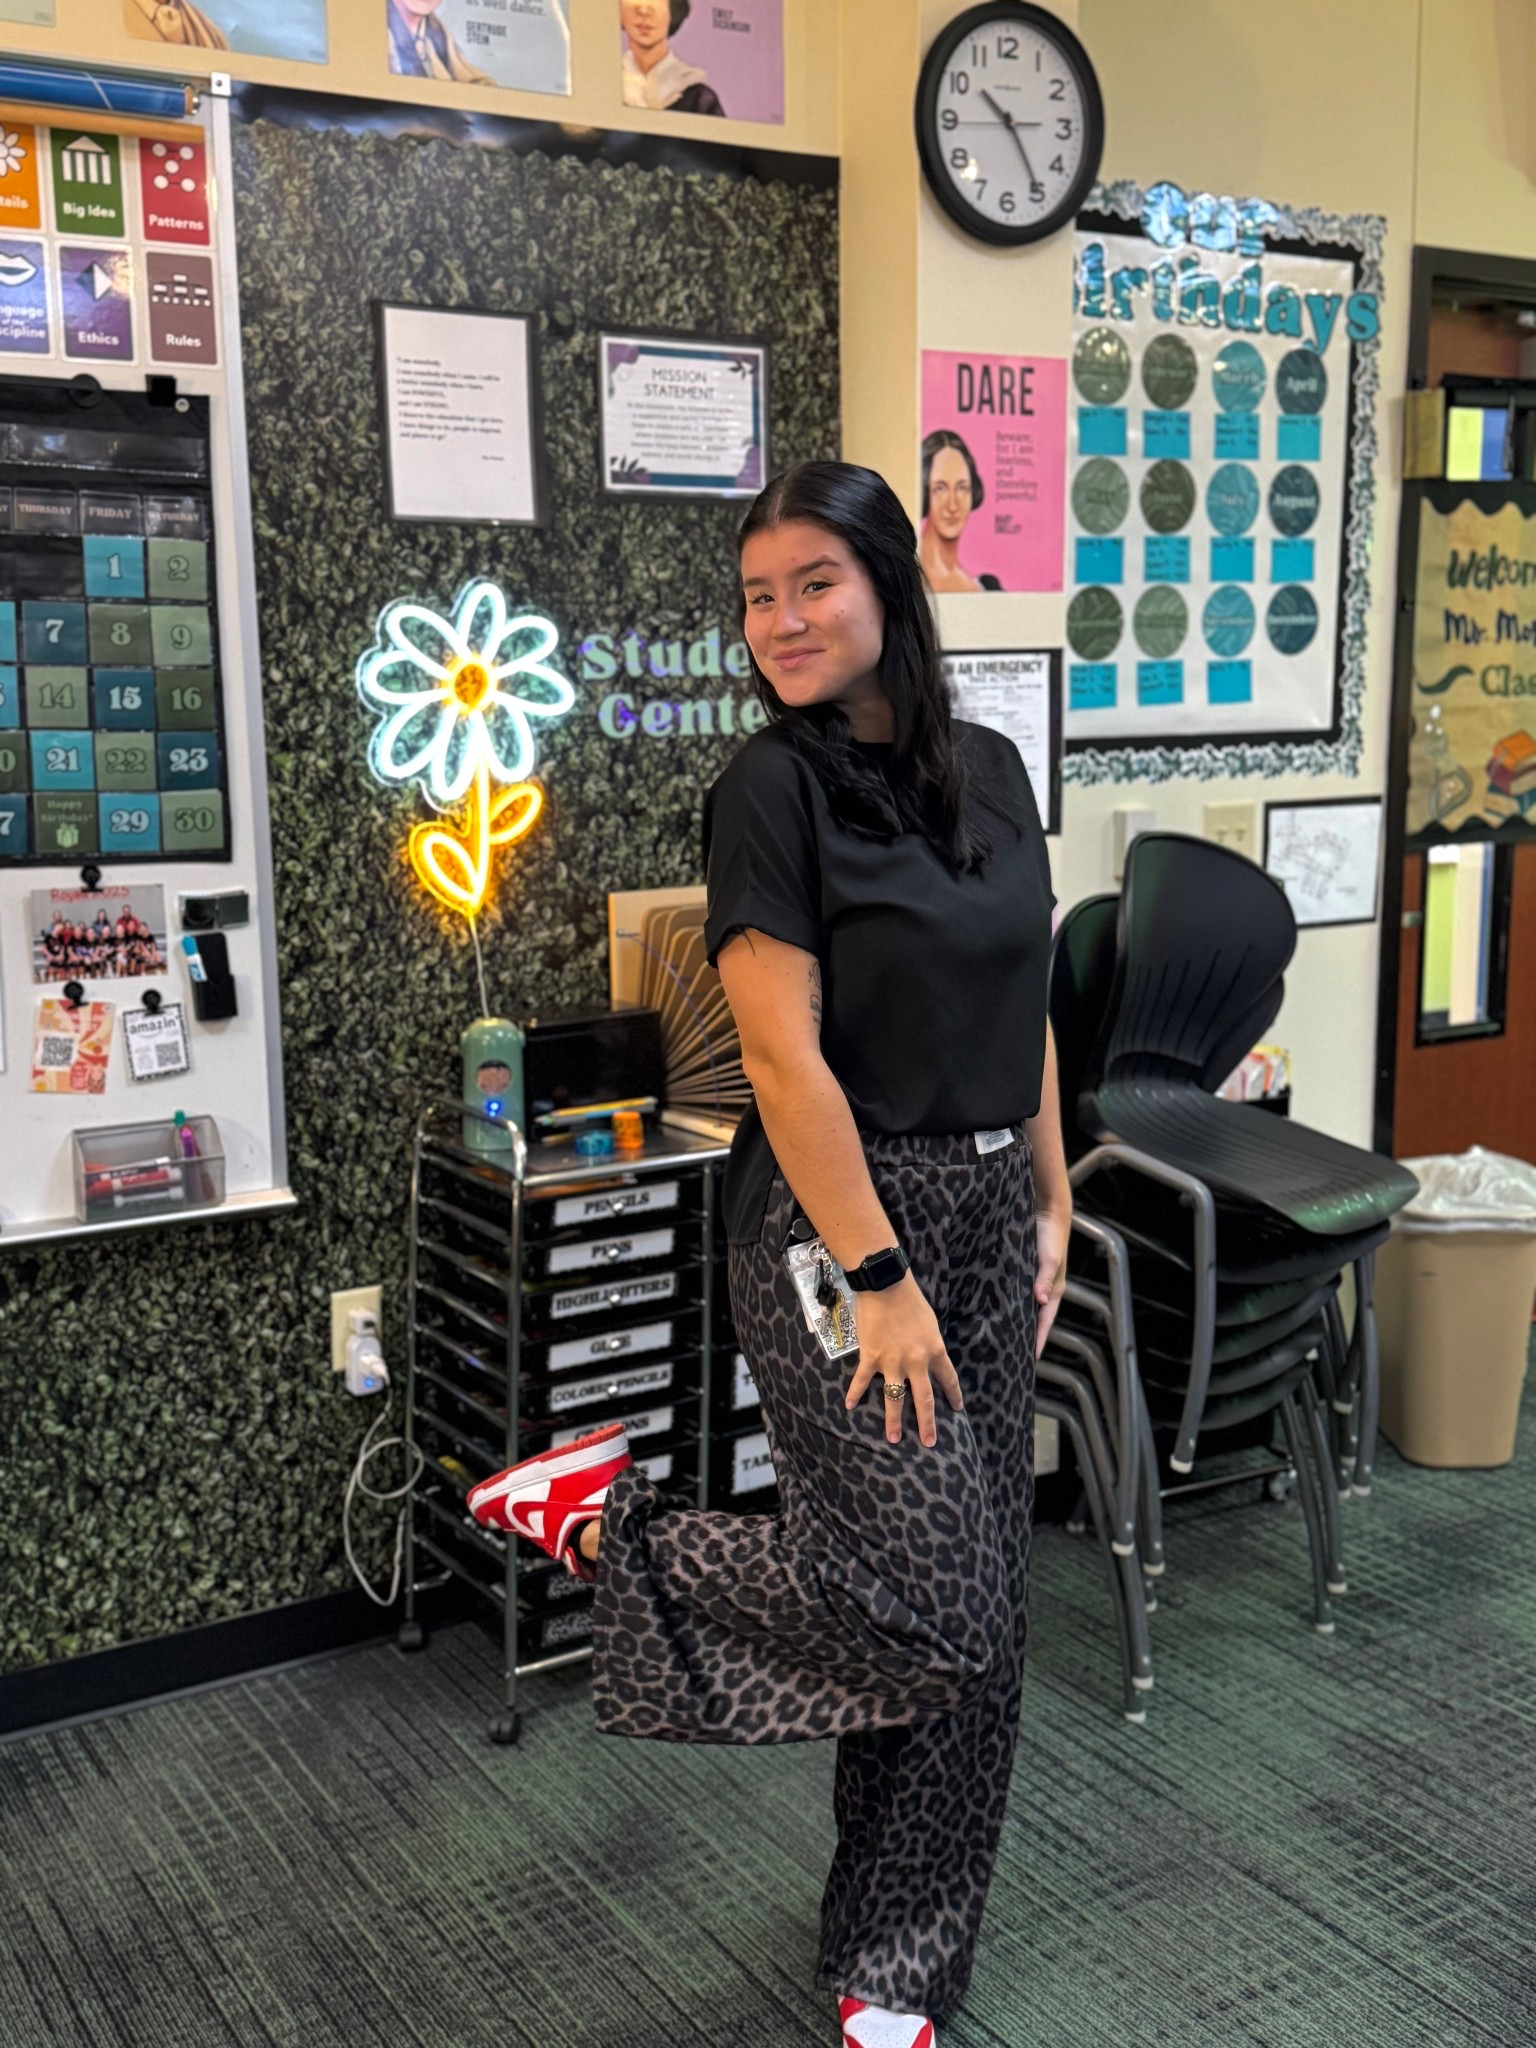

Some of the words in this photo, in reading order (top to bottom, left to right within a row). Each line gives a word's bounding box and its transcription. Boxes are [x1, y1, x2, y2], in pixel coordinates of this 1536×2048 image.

[466, 20, 507, 37] GERTRUDE
[466, 32, 489, 45] STEIN
[972, 44, 987, 68] 11
[998, 36, 1019, 60] 12
[1035, 51, 1041, 72] 1
[950, 71, 969, 95] 10
[1049, 79, 1065, 101] 2
[941, 109, 958, 131] 9
[1055, 118, 1072, 140] 3
[950, 147, 968, 169] 8
[1049, 154, 1064, 175] 4
[974, 179, 987, 201] 7
[1029, 181, 1045, 203] 5
[62, 202, 87, 218] Big
[88, 204, 116, 219] Idea
[999, 191, 1015, 213] 6
[148, 214, 204, 231] Patterns
[78, 331, 119, 345] Ethics
[166, 333, 201, 348] Rules
[652, 367, 707, 384] MISSION
[644, 383, 714, 400] STATEMENT
[957, 363, 1035, 416] DARE
[19, 503, 73, 516] THURSDAY
[89, 506, 133, 520] FRIDAY
[107, 552, 123, 580] 1
[167, 555, 190, 581] 2
[45, 618, 64, 645] 7
[109, 622, 132, 647] 8
[170, 625, 193, 651] 9
[957, 661, 973, 675] AN
[976, 659, 1043, 675] EMERGENCY
[40, 682, 75, 711] 14
[109, 686, 142, 712] 15
[171, 687, 202, 712] 16
[46, 747, 80, 773] 21
[106, 748, 148, 774] 22
[169, 748, 208, 773] 23
[47, 799, 83, 811] Happy
[111, 809, 150, 833] 29
[174, 808, 215, 832] 30
[583, 1191, 649, 1216] PENCILS
[556, 1277, 671, 1312] HIGHLIGHTERS
[616, 1369, 669, 1388] PENCILS
